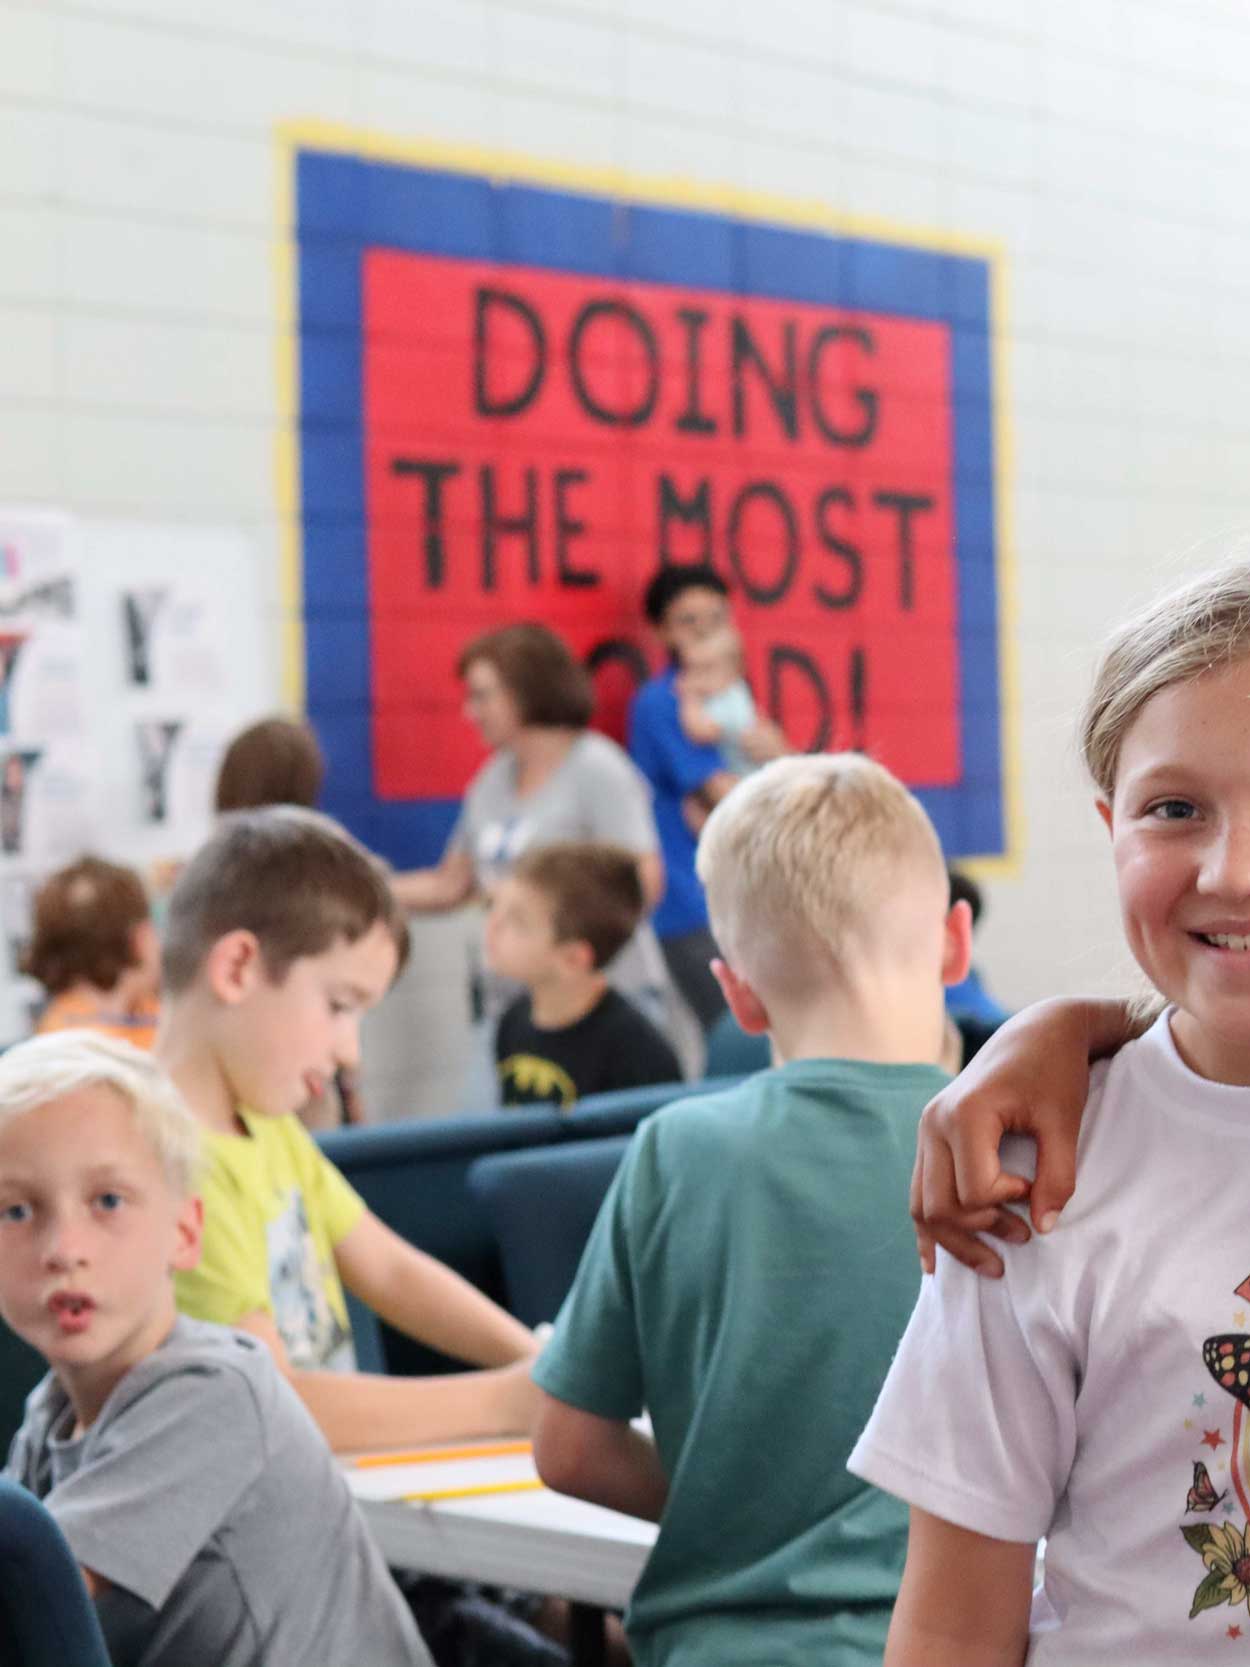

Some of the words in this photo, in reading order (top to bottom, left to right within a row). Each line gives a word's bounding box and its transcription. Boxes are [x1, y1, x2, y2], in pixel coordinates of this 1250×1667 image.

[474, 286, 877, 449] DOING
[391, 458, 600, 592] THE
[655, 472, 936, 612] MOST
